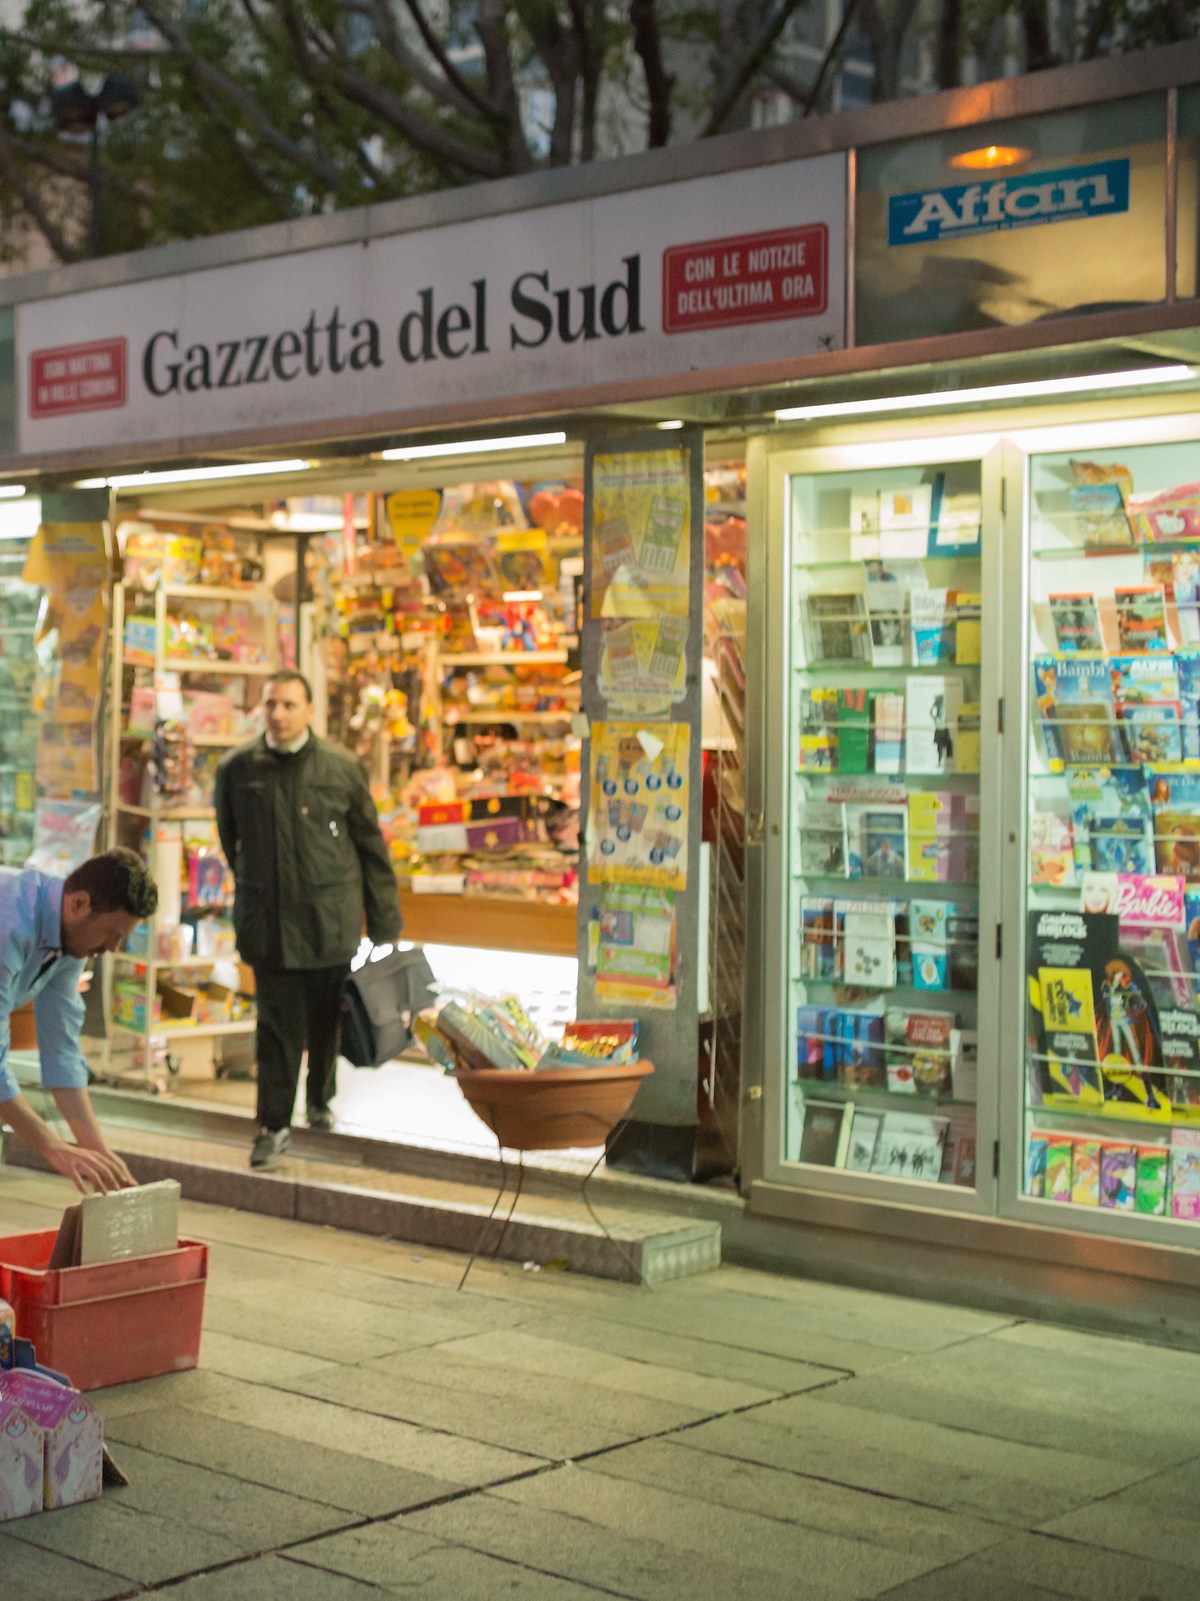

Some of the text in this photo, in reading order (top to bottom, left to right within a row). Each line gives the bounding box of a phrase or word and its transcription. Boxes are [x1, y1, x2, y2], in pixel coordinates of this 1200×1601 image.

[685, 242, 806, 283] CON LE NOTIZIE
[677, 273, 815, 315] DELL'ULTIMA ORA
[142, 252, 647, 397] Gazzetta del Sud
[1114, 882, 1179, 918] Barbie
